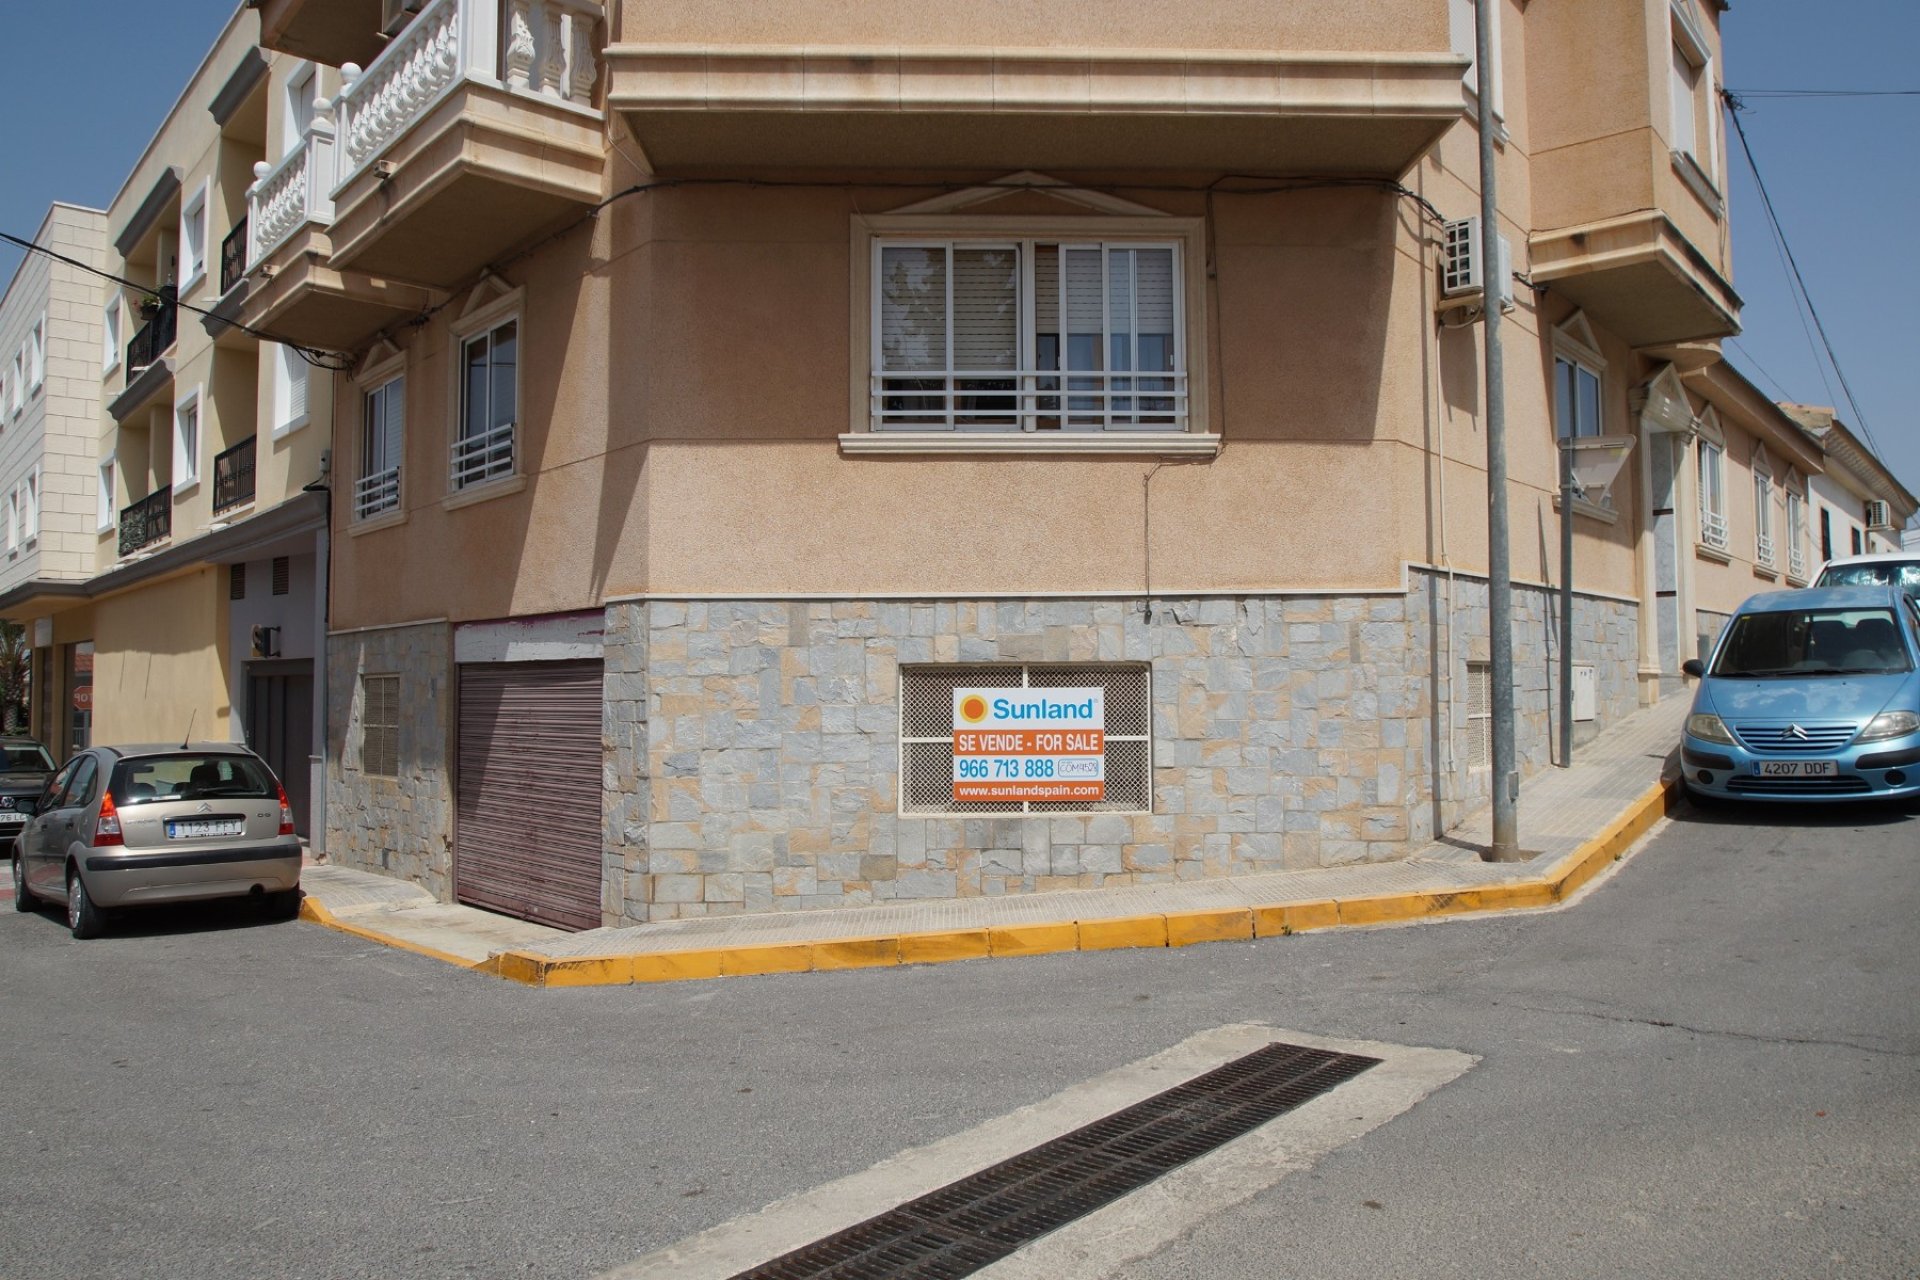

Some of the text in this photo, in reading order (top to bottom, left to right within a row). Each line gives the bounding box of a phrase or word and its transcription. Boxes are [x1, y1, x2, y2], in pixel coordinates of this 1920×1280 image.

[993, 698, 1093, 719] Sunland
[959, 734, 976, 751] SE
[979, 734, 1023, 751] VENDE
[1036, 734, 1062, 751] FOR
[1066, 734, 1099, 751] SALE
[959, 759, 1054, 778] 966 713 888
[1764, 762, 1831, 775] 4207 DDF
[959, 785, 1099, 797] www.sunlandspain.com
[180, 819, 238, 834] 1123 FFY
